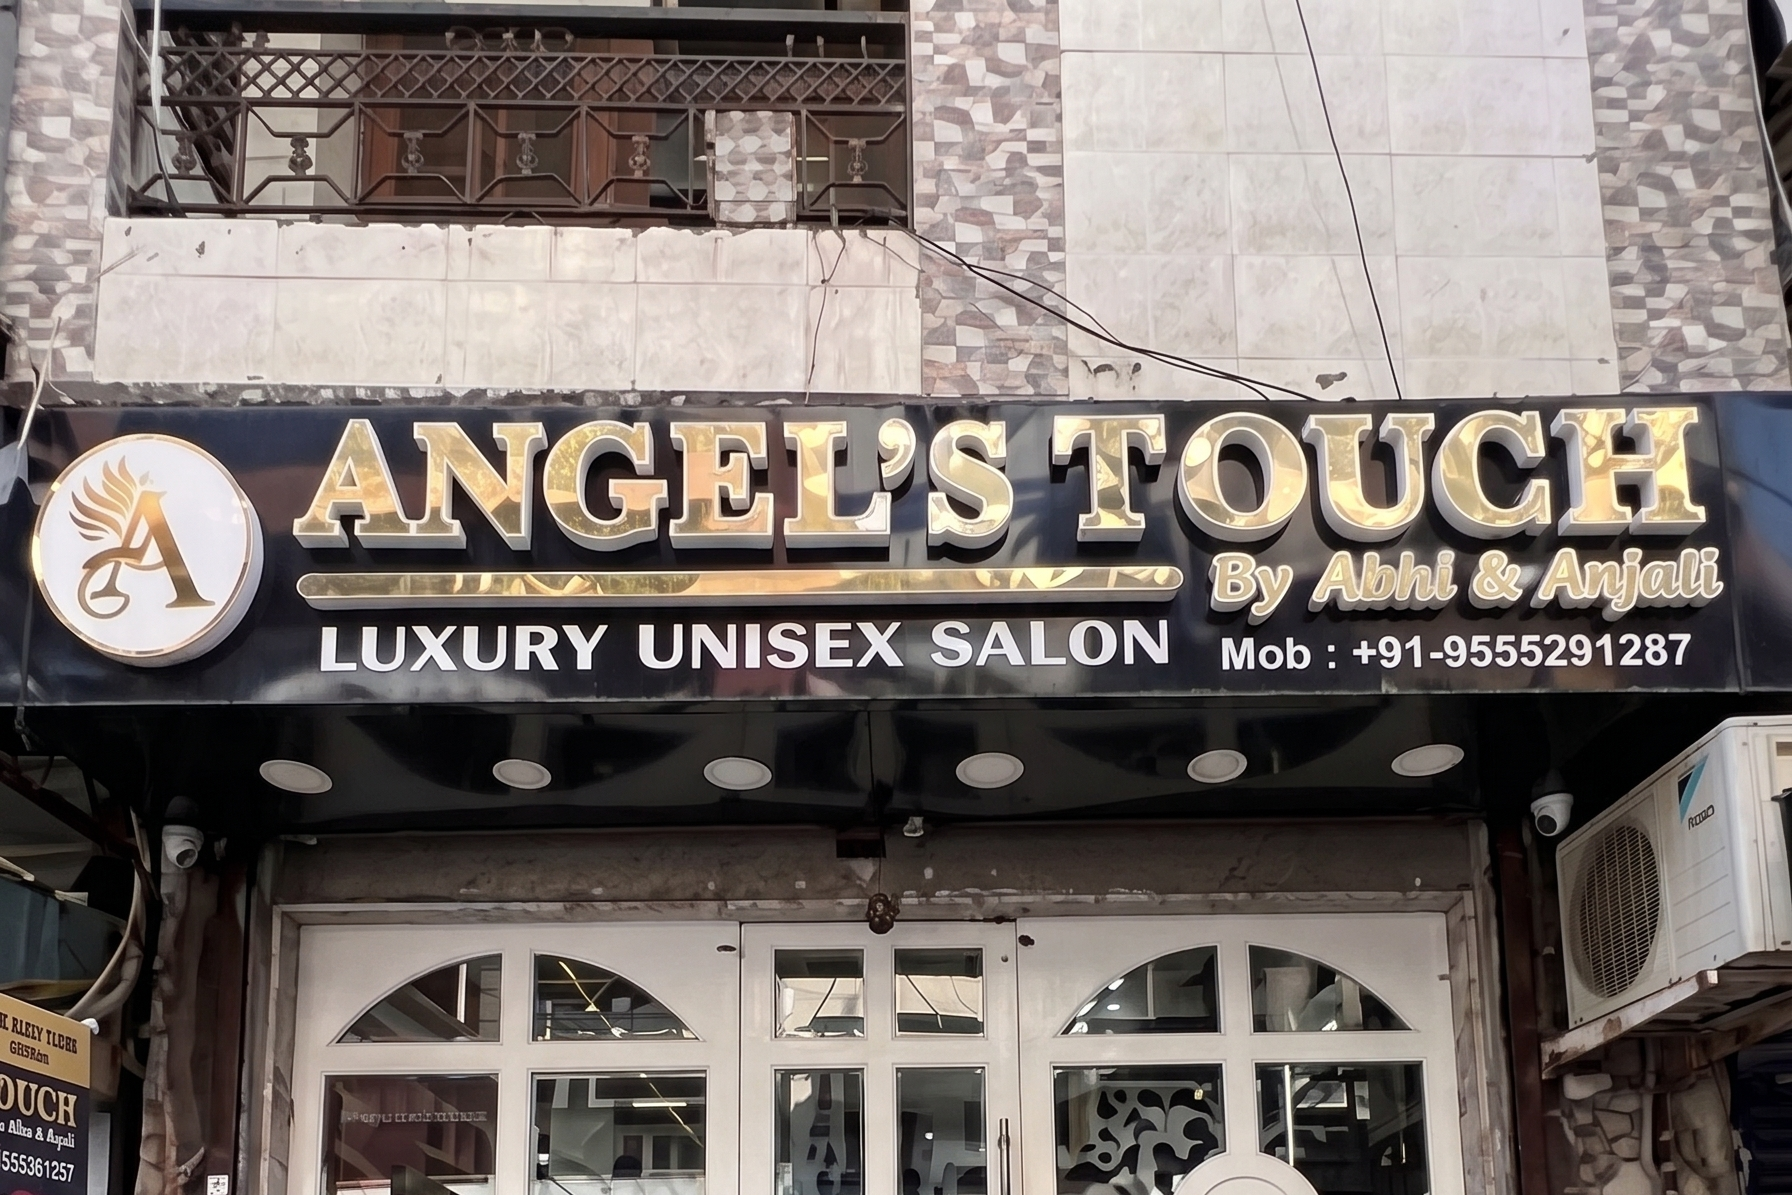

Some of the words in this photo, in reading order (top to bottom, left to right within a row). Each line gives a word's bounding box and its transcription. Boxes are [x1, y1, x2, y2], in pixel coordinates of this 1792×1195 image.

[293, 418, 1013, 552] ANGEL'S
[1052, 407, 1706, 543] TOUCH
[1210, 552, 1294, 625] By
[1308, 550, 1457, 612] Abhi
[1468, 549, 1523, 609] &
[1530, 547, 1724, 622] Anjali
[320, 624, 609, 672] LUXURY
[638, 620, 904, 669] UNISEX
[930, 619, 1169, 667] SALON
[1221, 637, 1311, 670] Mob
[1353, 632, 1692, 668] +91-9555291287
